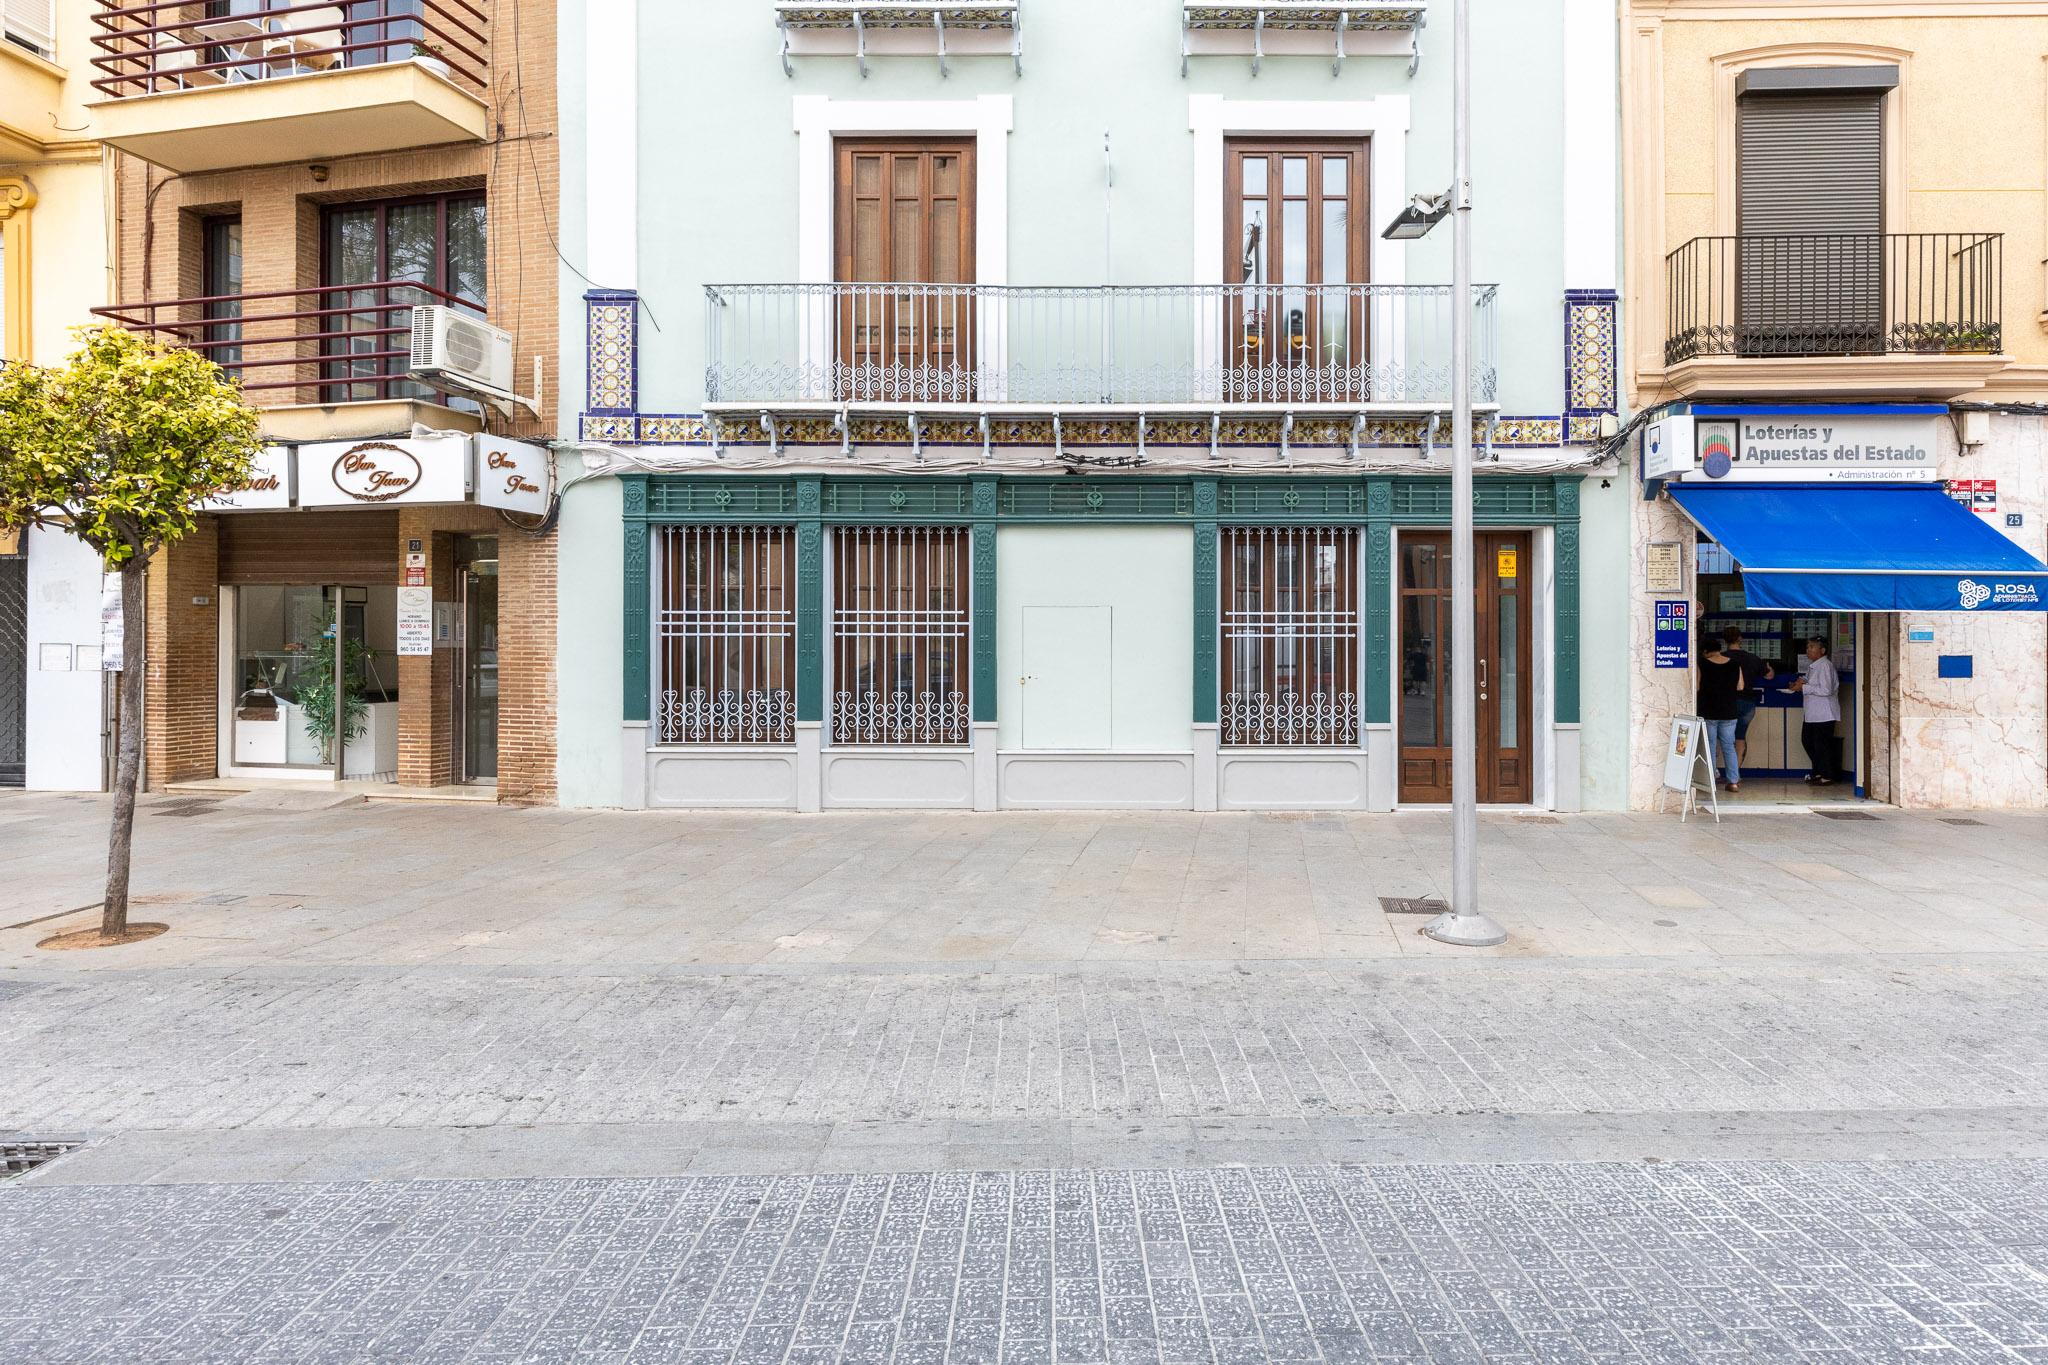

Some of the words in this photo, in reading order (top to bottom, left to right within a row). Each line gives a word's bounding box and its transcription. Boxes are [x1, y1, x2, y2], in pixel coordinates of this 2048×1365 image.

[1745, 424, 1817, 440] Loterías
[1822, 428, 1833, 444] y
[343, 454, 377, 474] San
[487, 451, 517, 470] San
[1746, 446, 1829, 464] Apuestas
[1833, 445, 1860, 461] del
[1865, 445, 1926, 461] Estado
[363, 470, 410, 492] Juan
[503, 474, 540, 494] Juan
[1837, 470, 1903, 479] Administración
[1920, 471, 1926, 479] 5
[2008, 515, 2020, 525] 25
[411, 541, 420, 550] 21
[1995, 584, 2036, 593] ROSA
